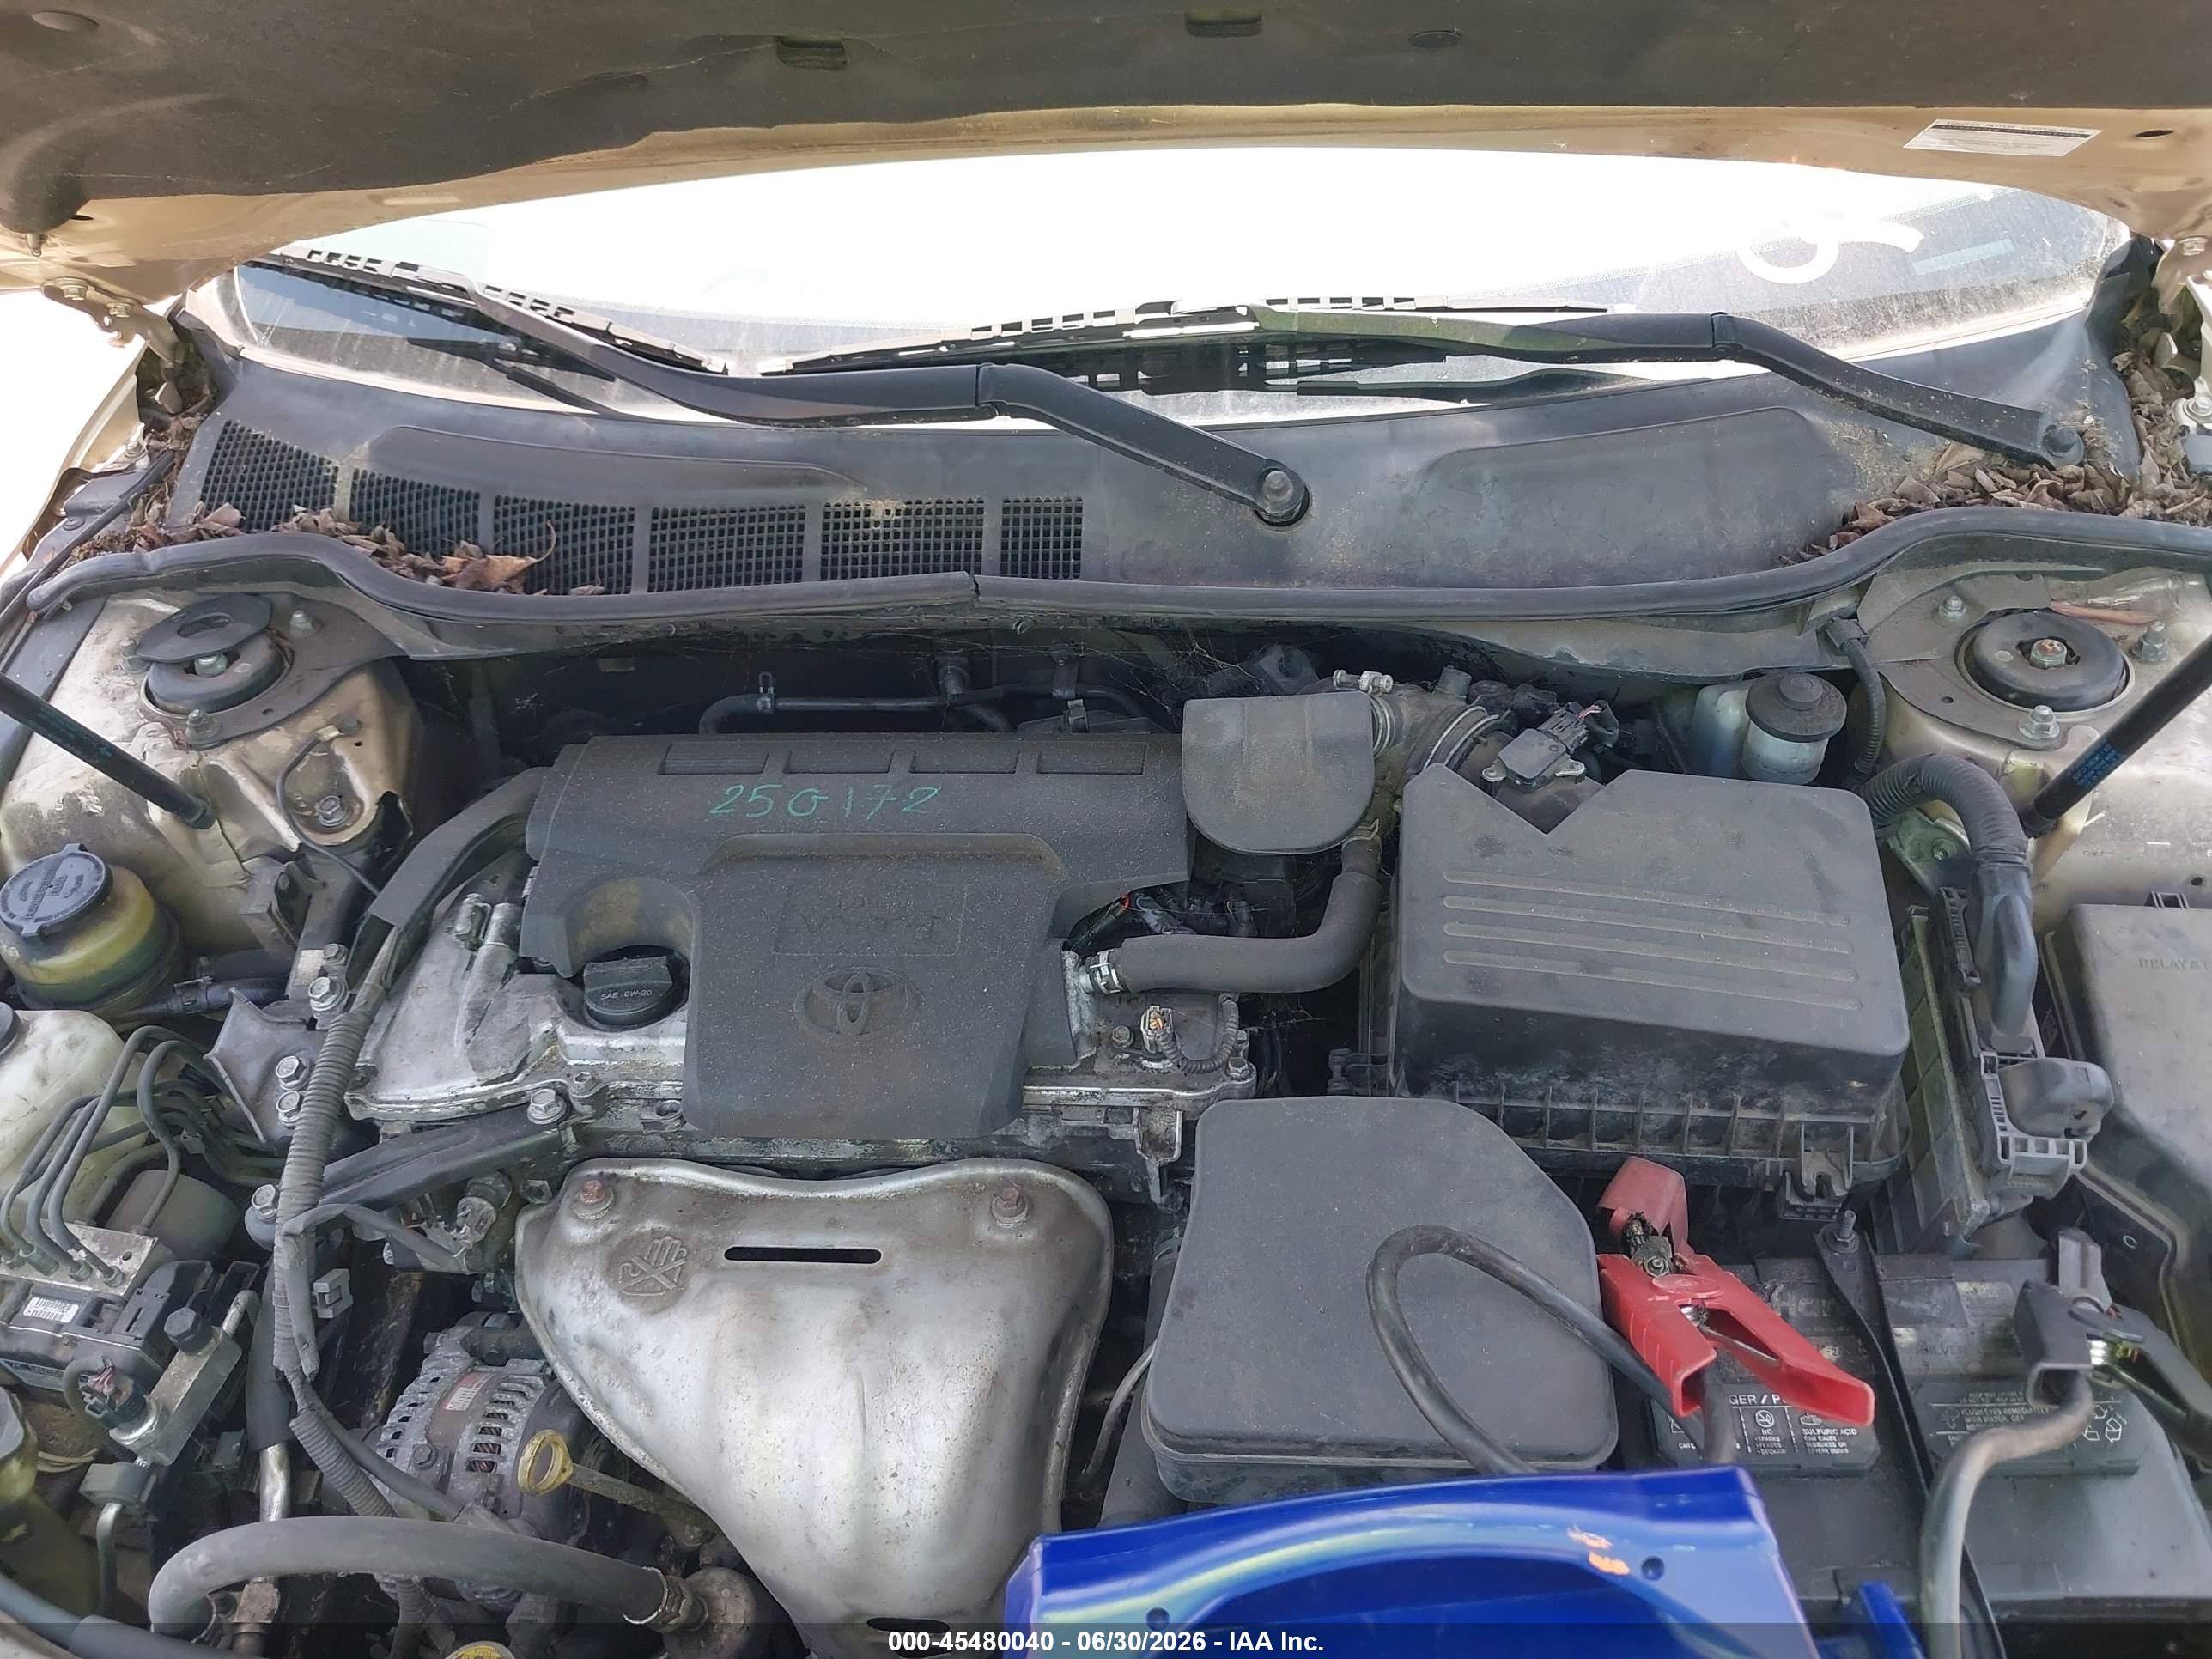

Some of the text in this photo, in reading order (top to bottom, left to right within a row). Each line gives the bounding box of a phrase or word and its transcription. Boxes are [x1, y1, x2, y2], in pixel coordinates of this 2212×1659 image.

[600, 989, 653, 1000] SAE 0W-20
[1729, 1394, 1757, 1406] GER
